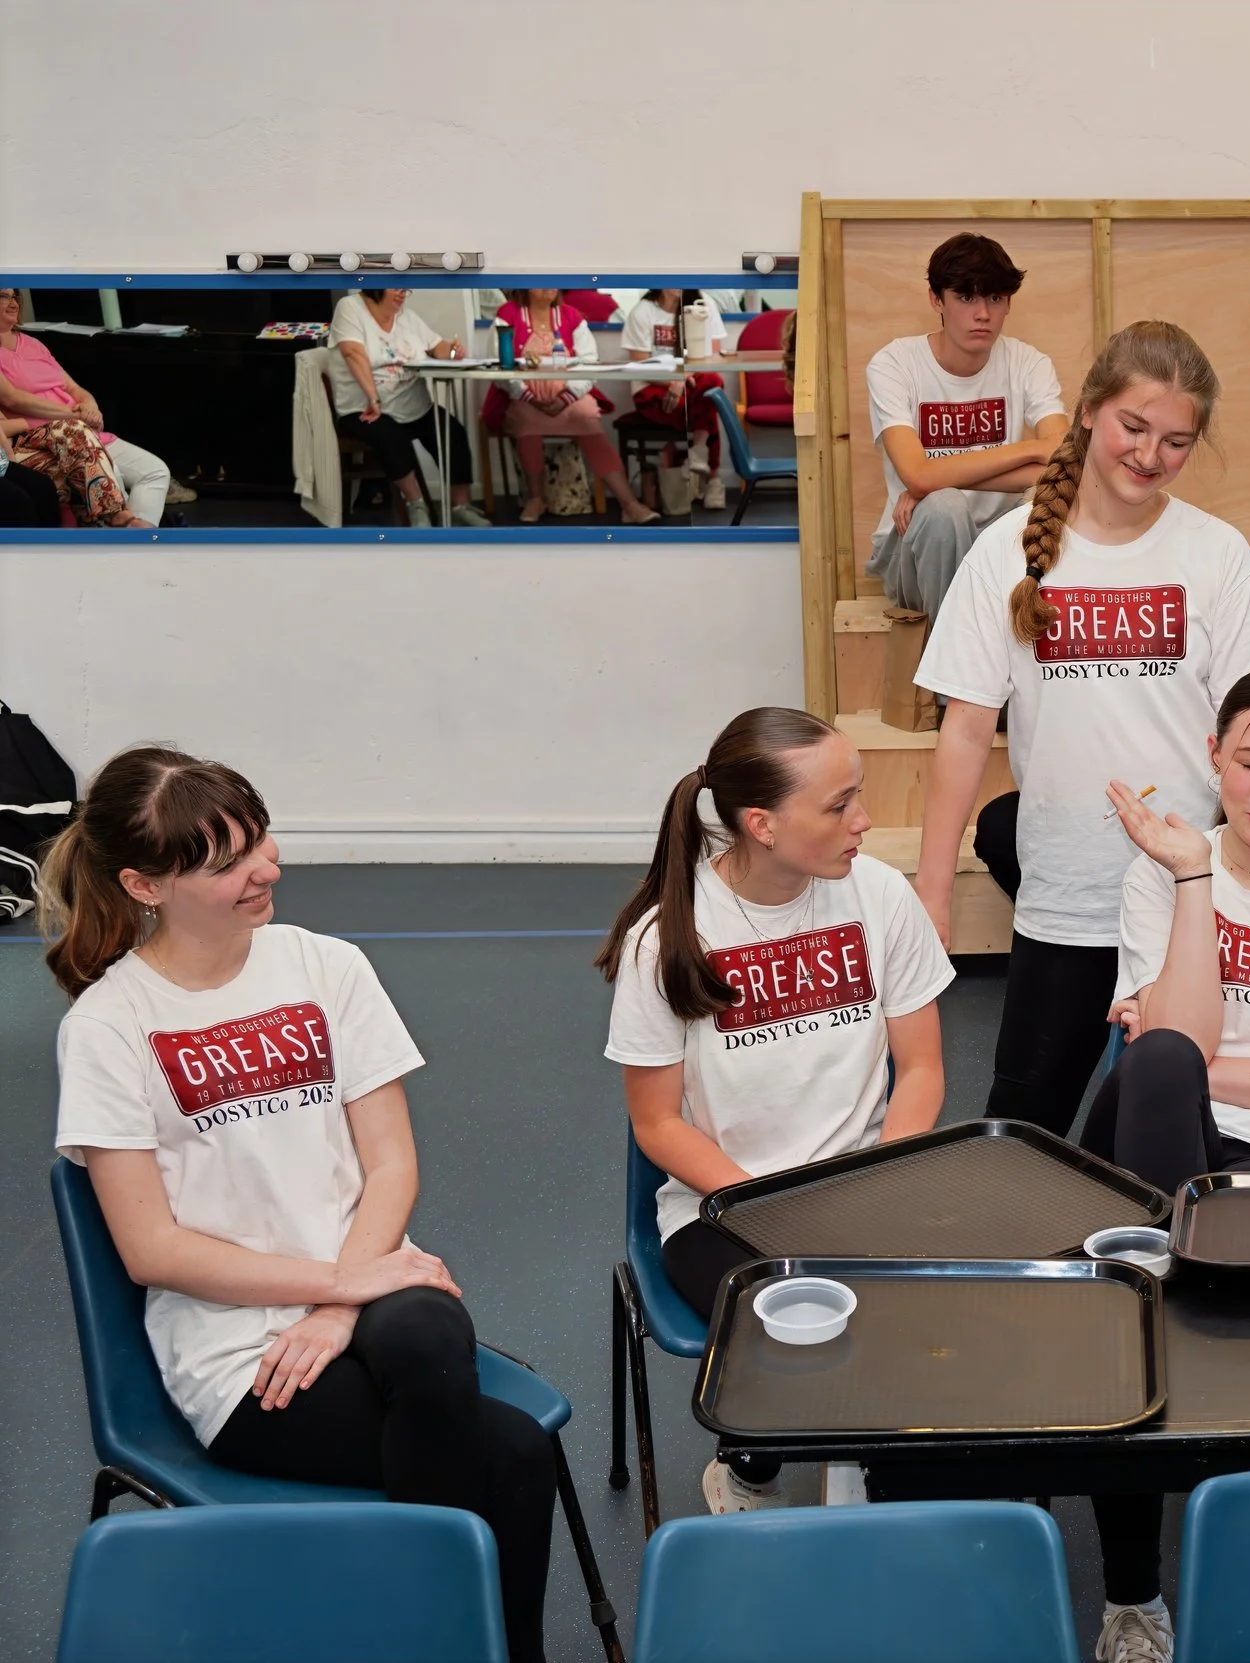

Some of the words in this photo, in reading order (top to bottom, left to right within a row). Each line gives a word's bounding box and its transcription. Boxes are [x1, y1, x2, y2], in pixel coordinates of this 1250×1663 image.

[928, 409, 1002, 436] GREASE
[1065, 593, 1079, 603] WE
[1084, 593, 1096, 603] GO
[1101, 592, 1151, 603] TOGETHER
[1046, 604, 1176, 641] GREASE
[1049, 646, 1059, 657] 19
[1066, 645, 1088, 656] THE
[1097, 644, 1153, 655] MUSICAL
[1166, 643, 1176, 653] 59
[1042, 664, 1129, 680] DOSYTCo
[1138, 661, 1178, 677] 2025
[1218, 917, 1228, 930] WE
[1233, 928, 1244, 938] GO
[740, 951, 755, 963] WE
[760, 948, 774, 960] GO
[779, 936, 829, 956] TOGETHER
[725, 944, 861, 1008] GREASE
[734, 1012, 744, 1024] 19
[753, 1006, 773, 1020] THE
[781, 992, 840, 1014] MUSICAL
[853, 987, 864, 999] 59
[191, 1034, 208, 1045] WE
[214, 1028, 229, 1041] GO
[231, 1011, 290, 1035] TOGETHER
[724, 1020, 819, 1050] DOSYTCo
[828, 1004, 872, 1027] 2025
[178, 1020, 327, 1086] GREASE
[196, 1091, 210, 1104] 19
[218, 1079, 245, 1096] THE
[252, 1067, 312, 1090] MUSICAL
[193, 1097, 288, 1134] DOSYTCo
